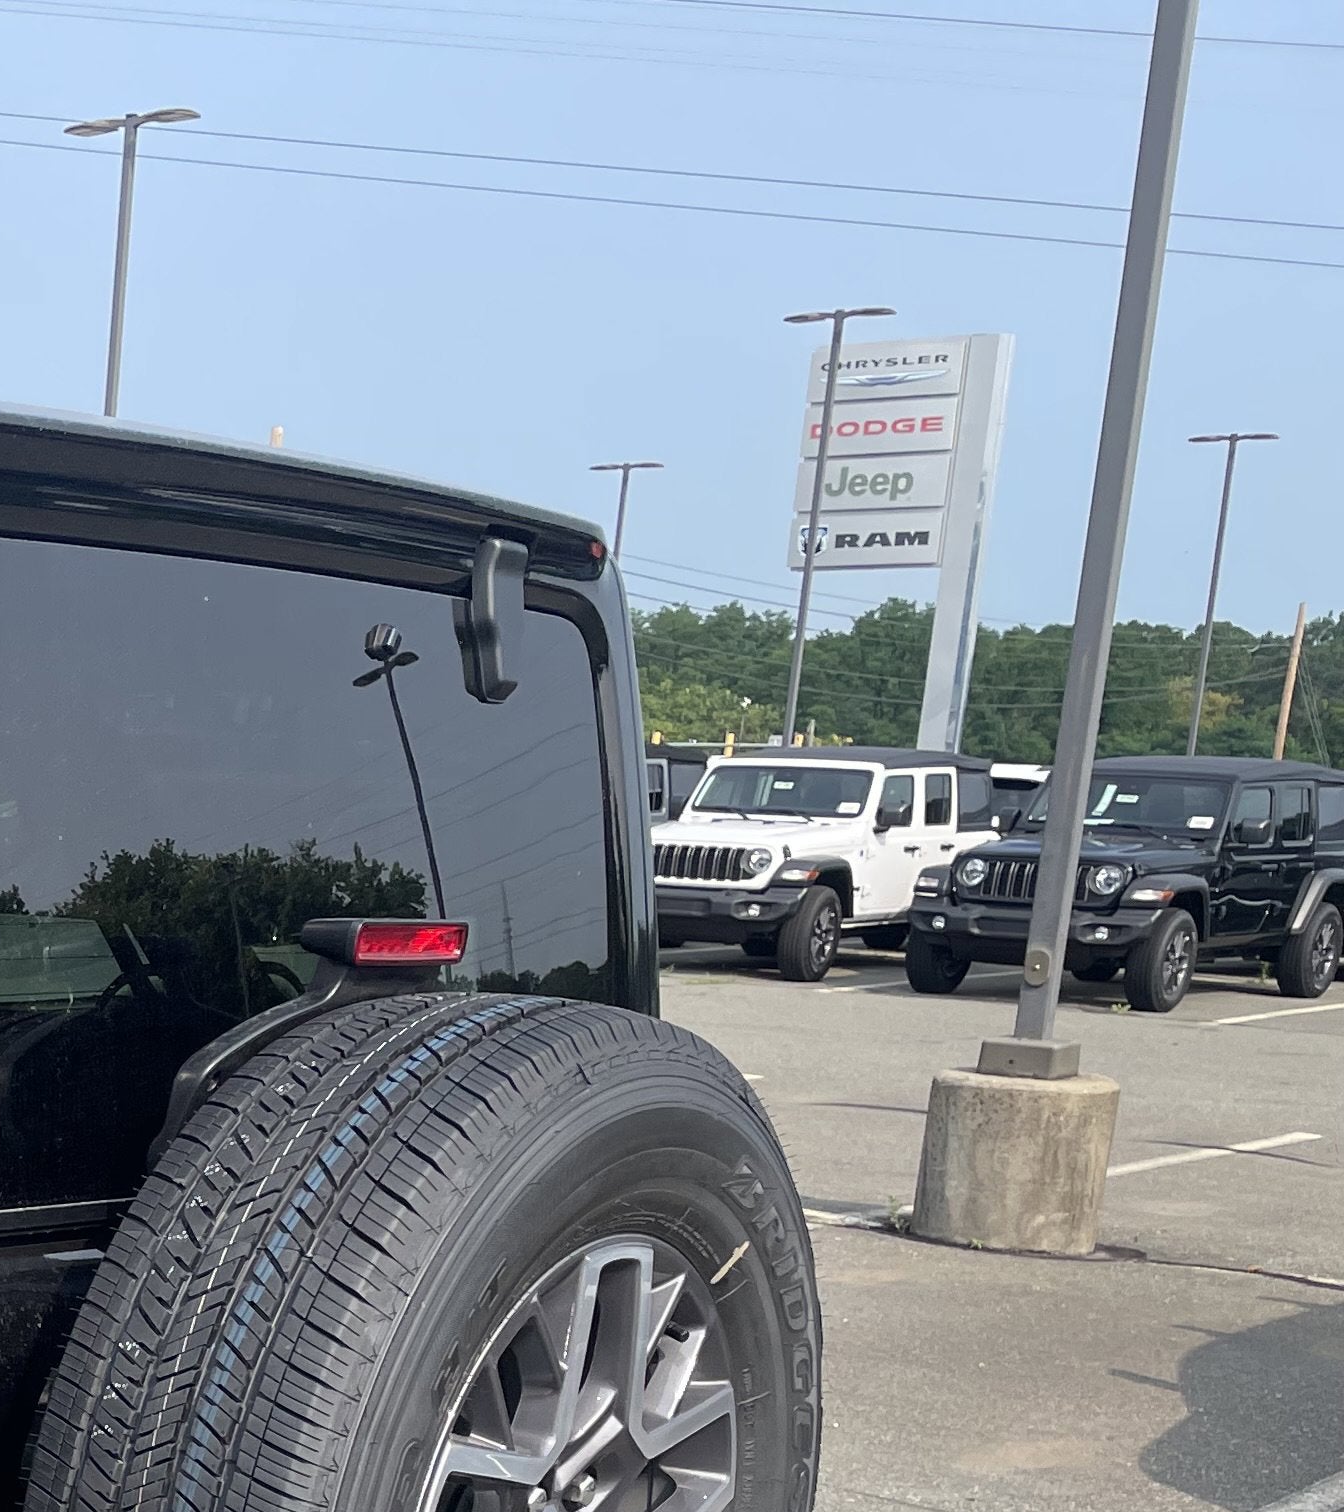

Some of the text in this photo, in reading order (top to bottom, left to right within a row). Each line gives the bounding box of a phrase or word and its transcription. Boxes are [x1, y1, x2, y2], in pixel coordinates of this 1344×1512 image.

[821, 354, 949, 371] CHRYSLER
[810, 416, 944, 439] DODGE
[825, 466, 914, 501] Jeep
[834, 531, 930, 548] RAM
